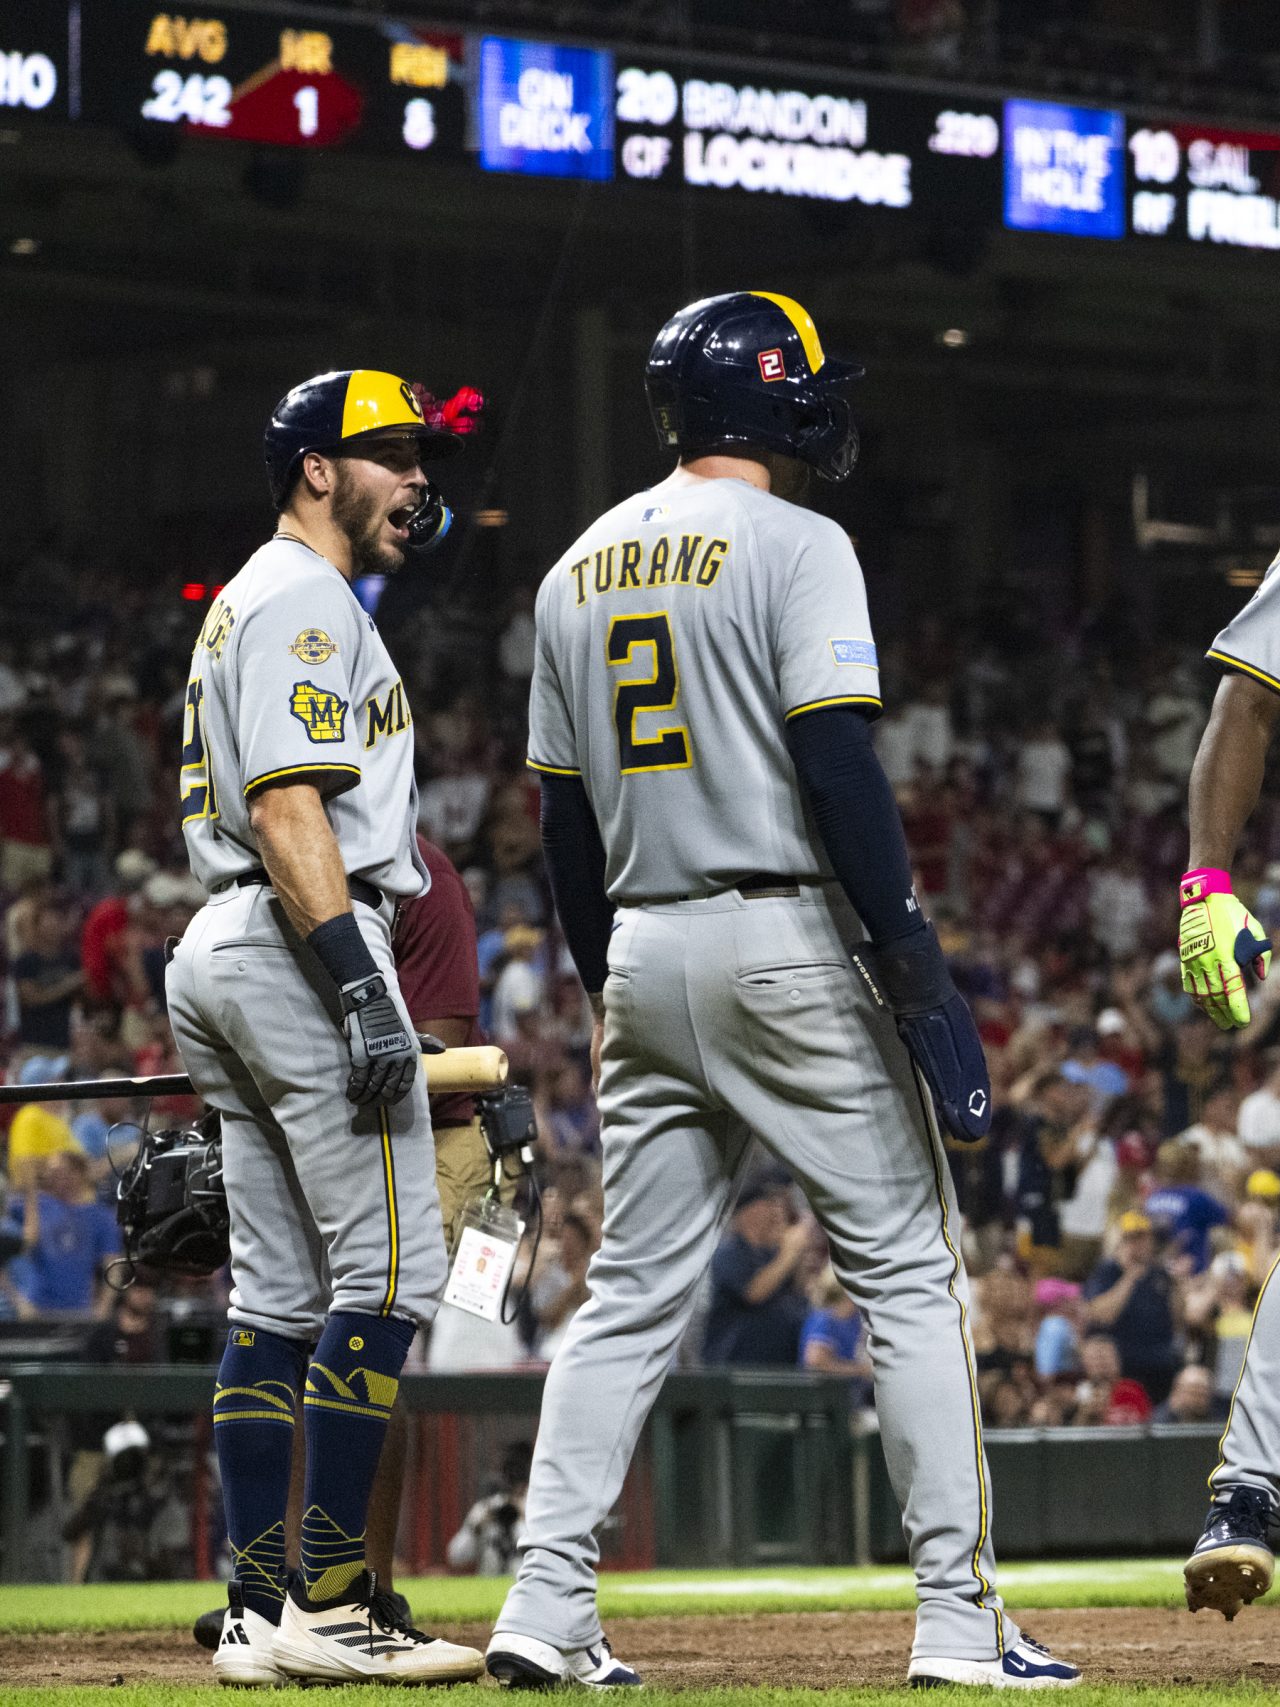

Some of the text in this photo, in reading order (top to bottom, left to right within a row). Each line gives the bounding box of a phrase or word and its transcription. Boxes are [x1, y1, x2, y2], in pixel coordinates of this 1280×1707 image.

[146, 13, 228, 64] AVG
[0, 51, 57, 109] IO
[142, 70, 232, 127] .242
[294, 87, 319, 138] 1
[517, 66, 574, 110] ON
[499, 103, 593, 155] DECK
[615, 68, 868, 149] 20 BRANDON
[682, 130, 912, 208] LOCKRIDGE
[1128, 128, 1261, 194] 10 SAL
[1020, 168, 1106, 213] HOLE
[760, 352, 783, 378] 2
[571, 534, 729, 608] TURANG
[308, 696, 336, 729] M
[363, 678, 412, 752] MI
[605, 609, 694, 776] 2
[852, 955, 884, 1006] EVOSHIELD
[368, 1031, 408, 1052] Franklin
